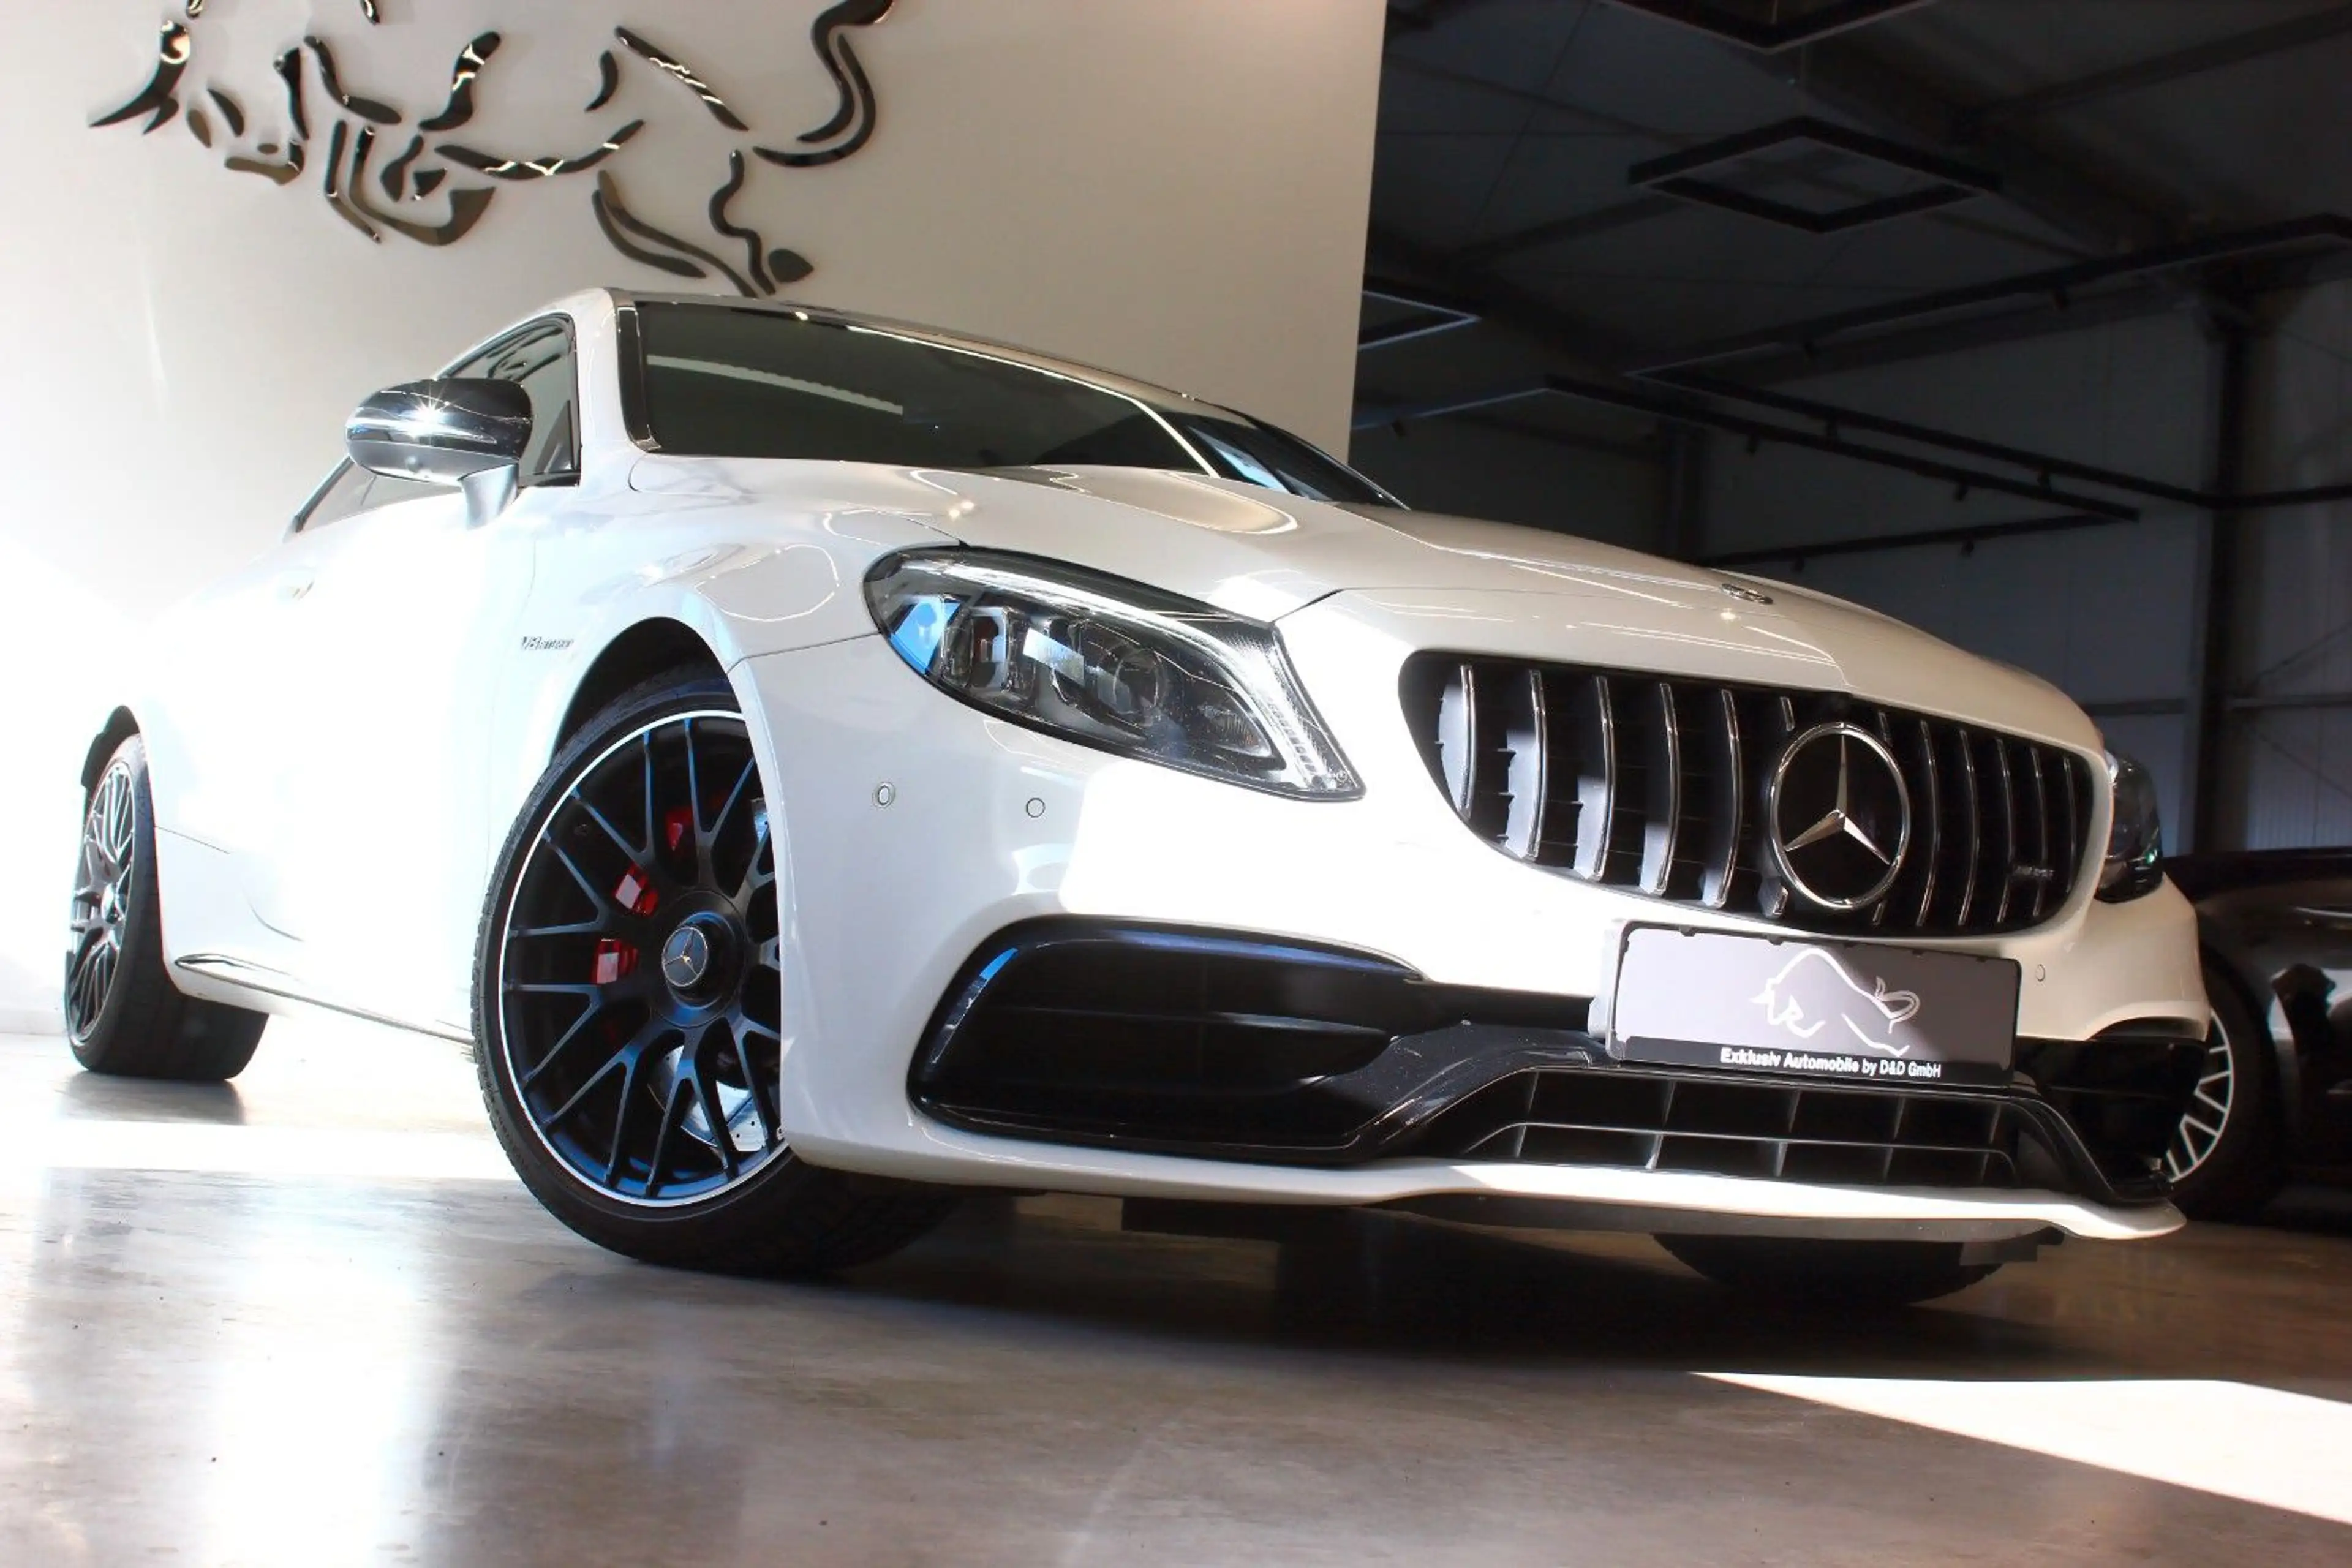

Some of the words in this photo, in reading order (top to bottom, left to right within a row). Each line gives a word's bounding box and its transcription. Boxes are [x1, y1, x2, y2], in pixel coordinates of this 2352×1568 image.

[1720, 1047, 1781, 1066] Exklusiv
[1782, 1052, 1859, 1073] Automobile
[1861, 1059, 1877, 1077] by
[1880, 1059, 1906, 1076] D&D
[1907, 1062, 1942, 1078] GmbH
